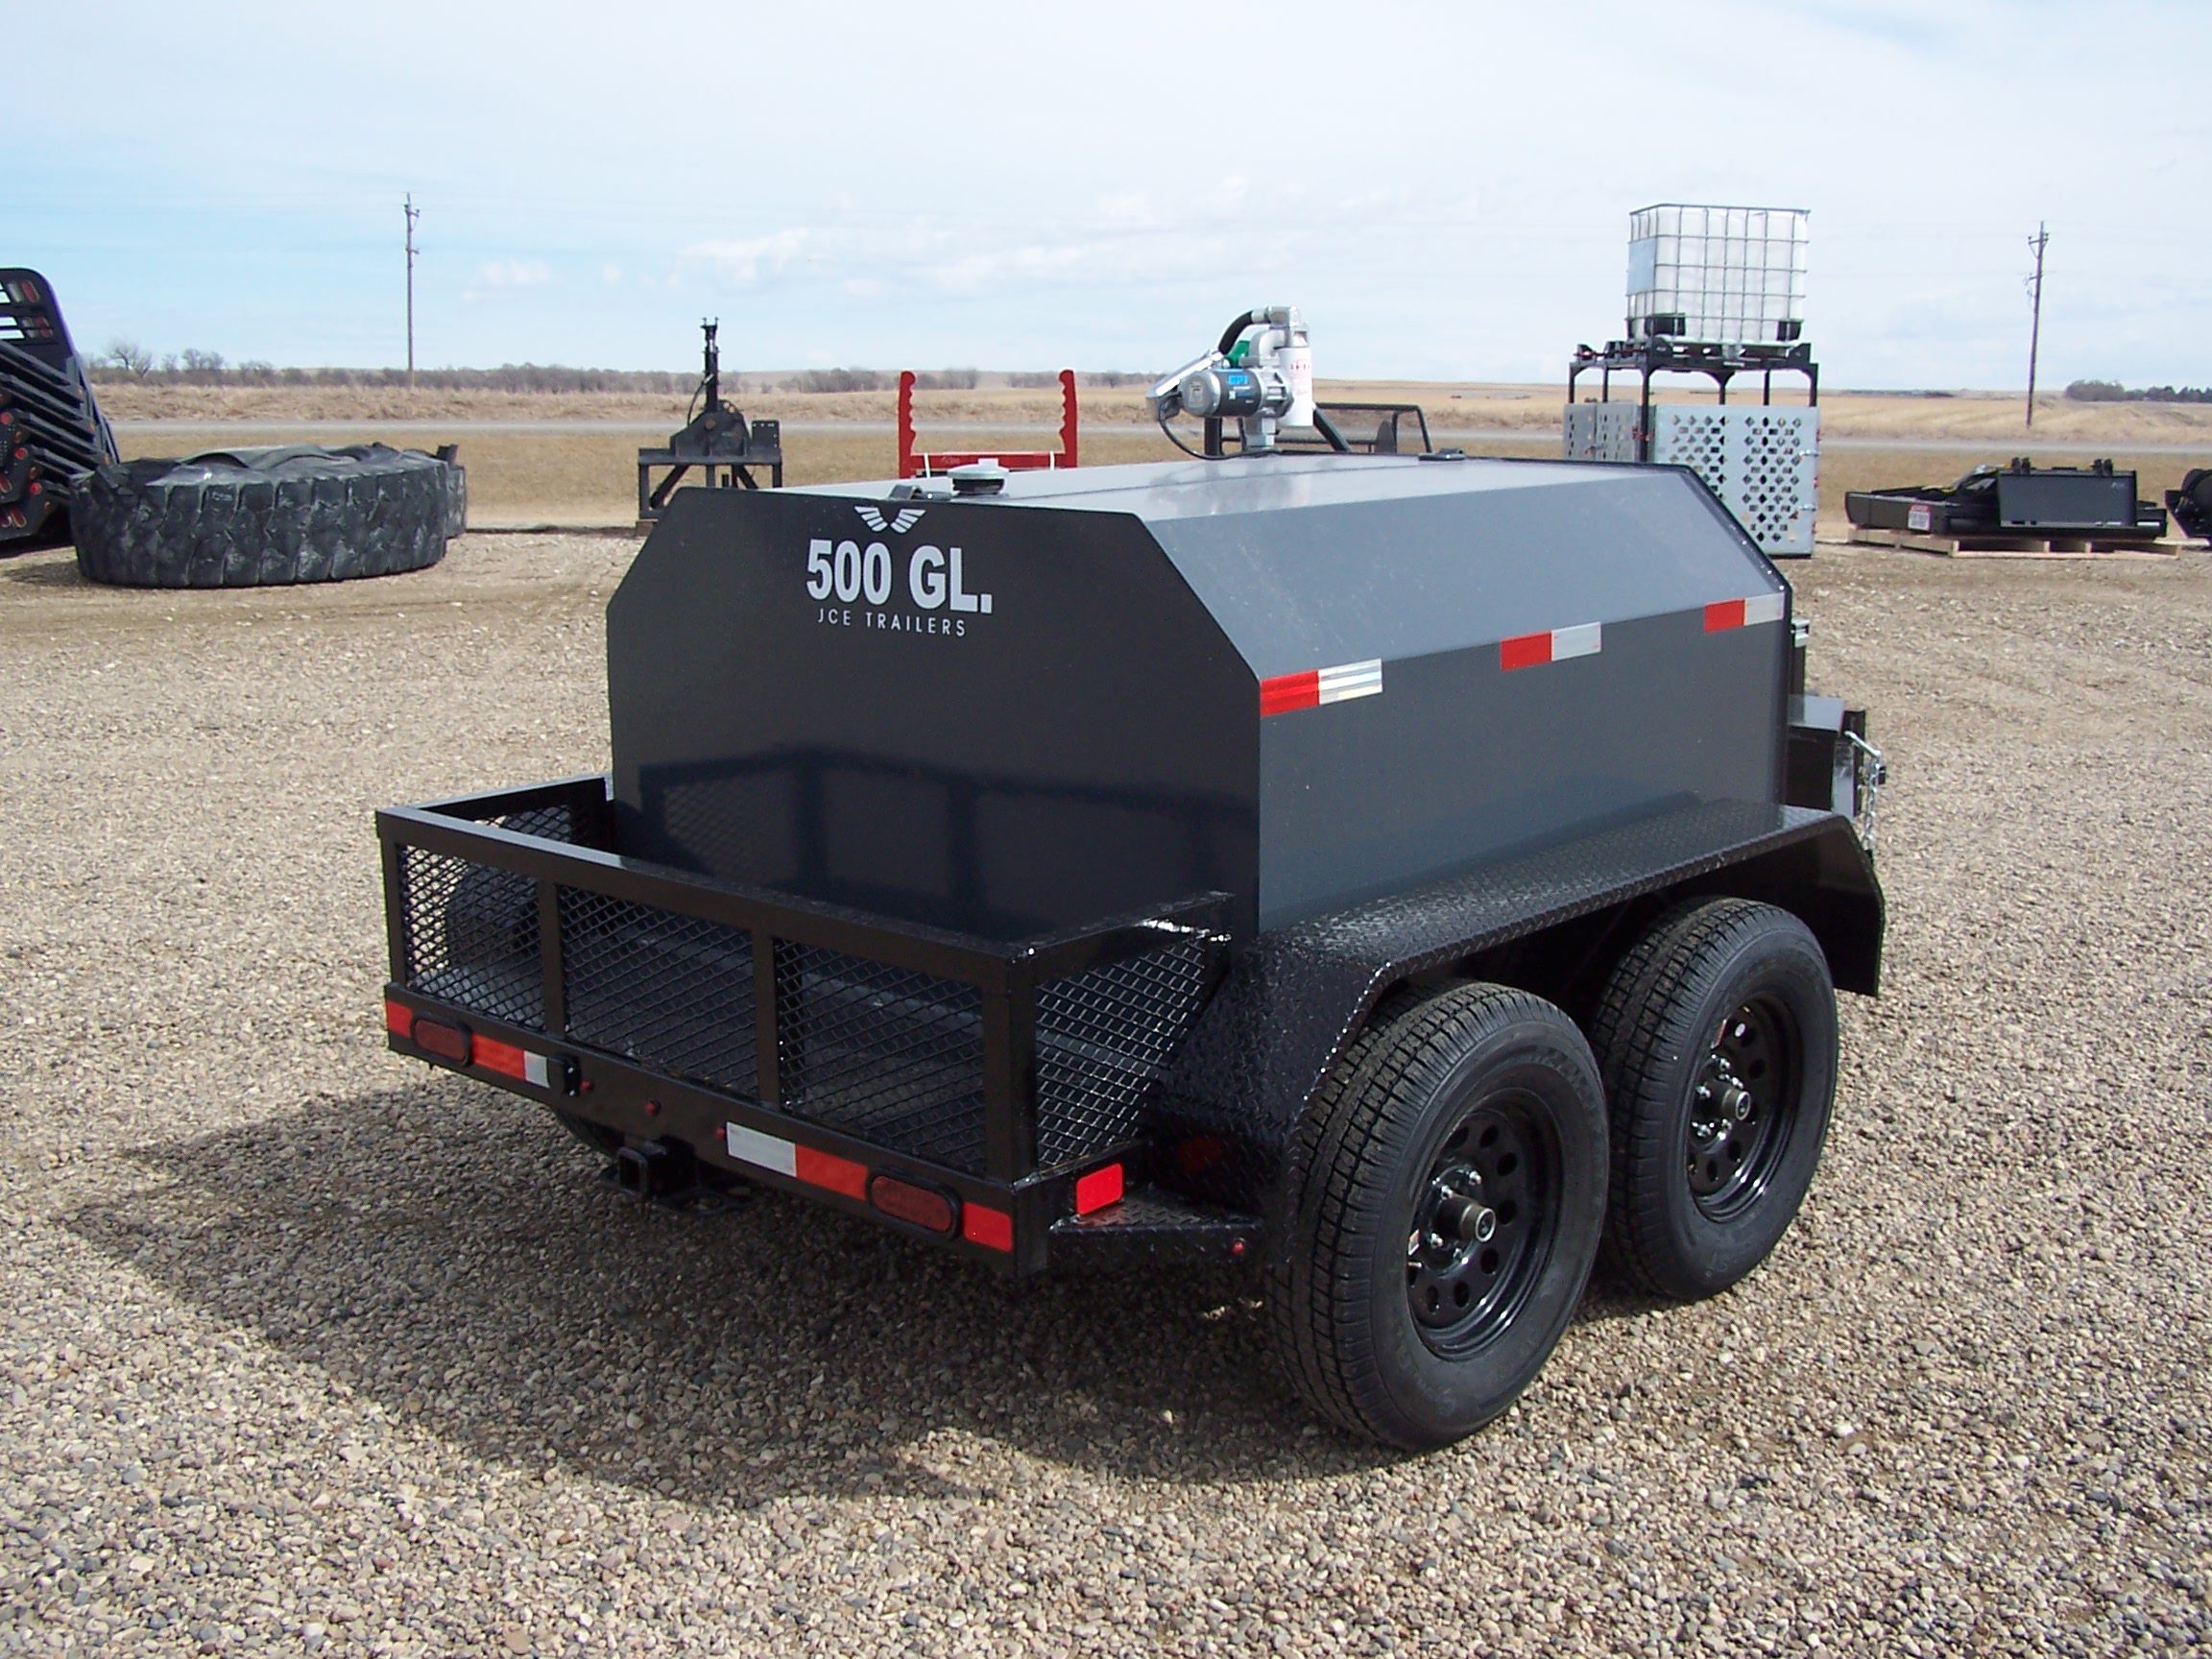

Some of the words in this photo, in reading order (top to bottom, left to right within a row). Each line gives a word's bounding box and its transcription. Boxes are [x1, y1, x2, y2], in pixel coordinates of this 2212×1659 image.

[806, 539, 892, 605] 500
[908, 544, 993, 613] GL.
[817, 608, 852, 626] JCE
[866, 612, 966, 637] TRAILERS
